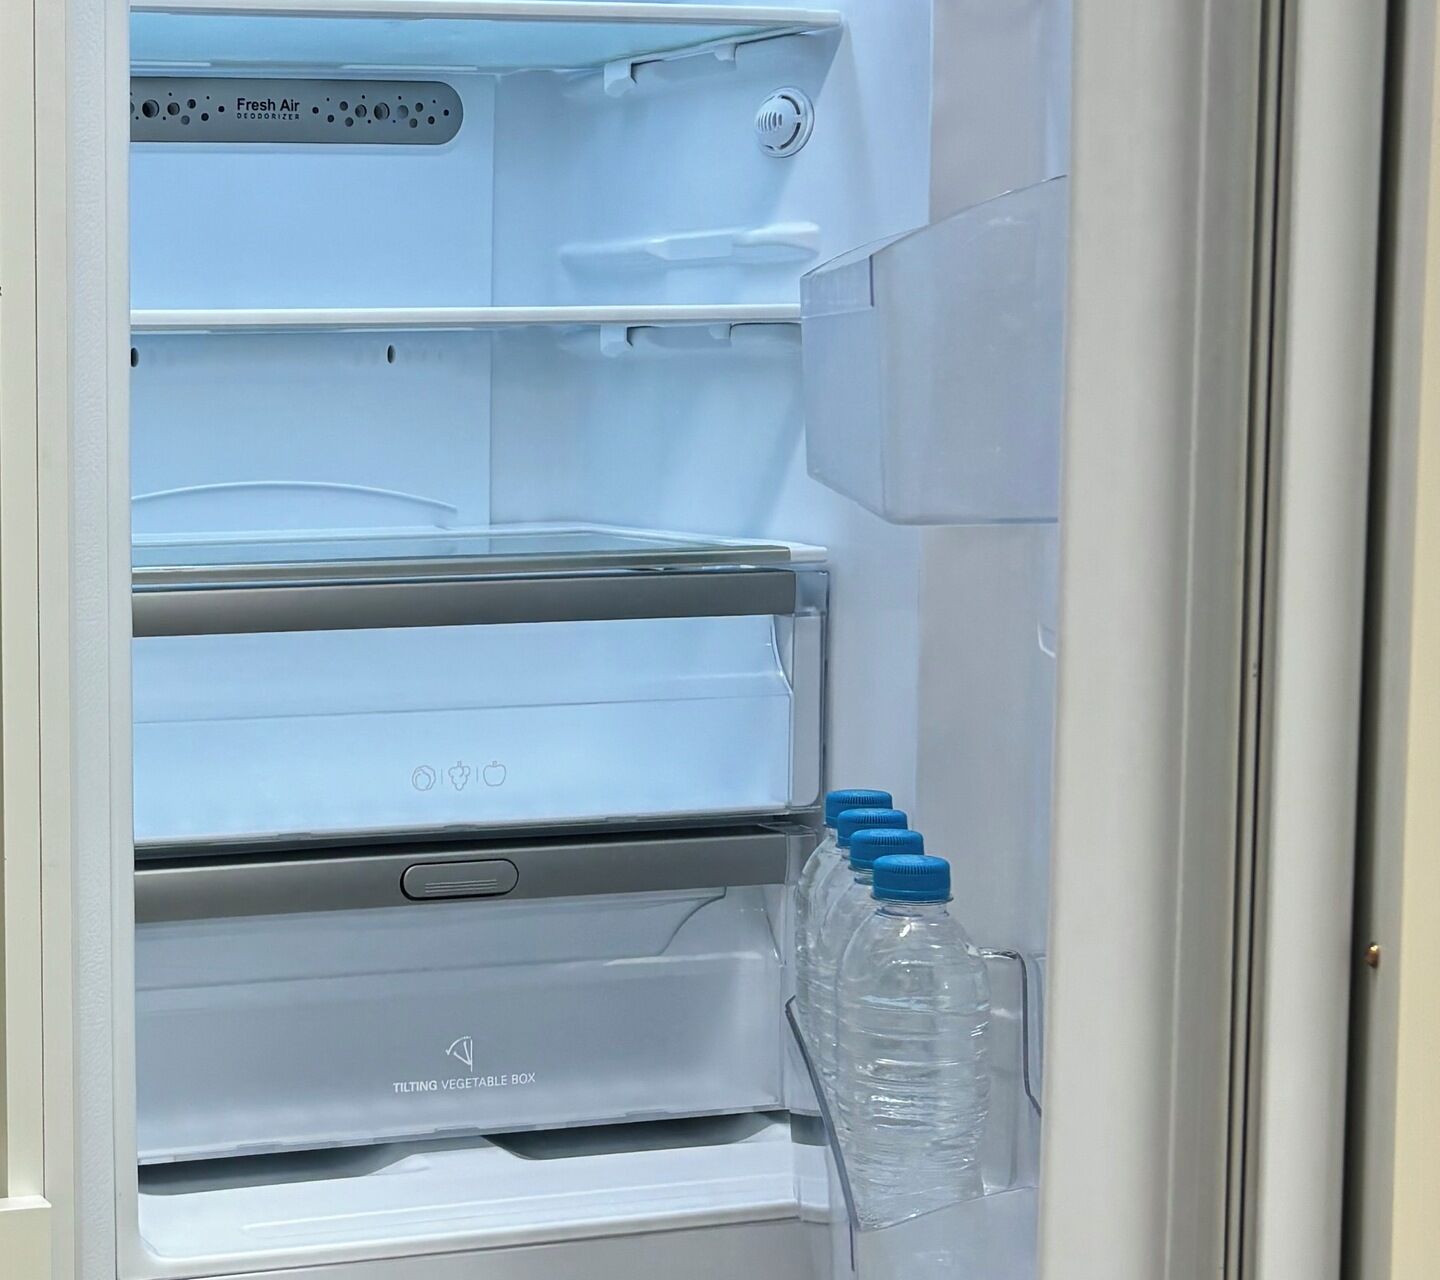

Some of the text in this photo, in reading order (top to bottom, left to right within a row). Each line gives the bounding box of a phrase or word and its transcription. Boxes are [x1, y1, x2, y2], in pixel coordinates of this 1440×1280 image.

[237, 98, 300, 112] Fresh Air
[392, 1072, 536, 1094] TILTING VEGETABLE BOX
